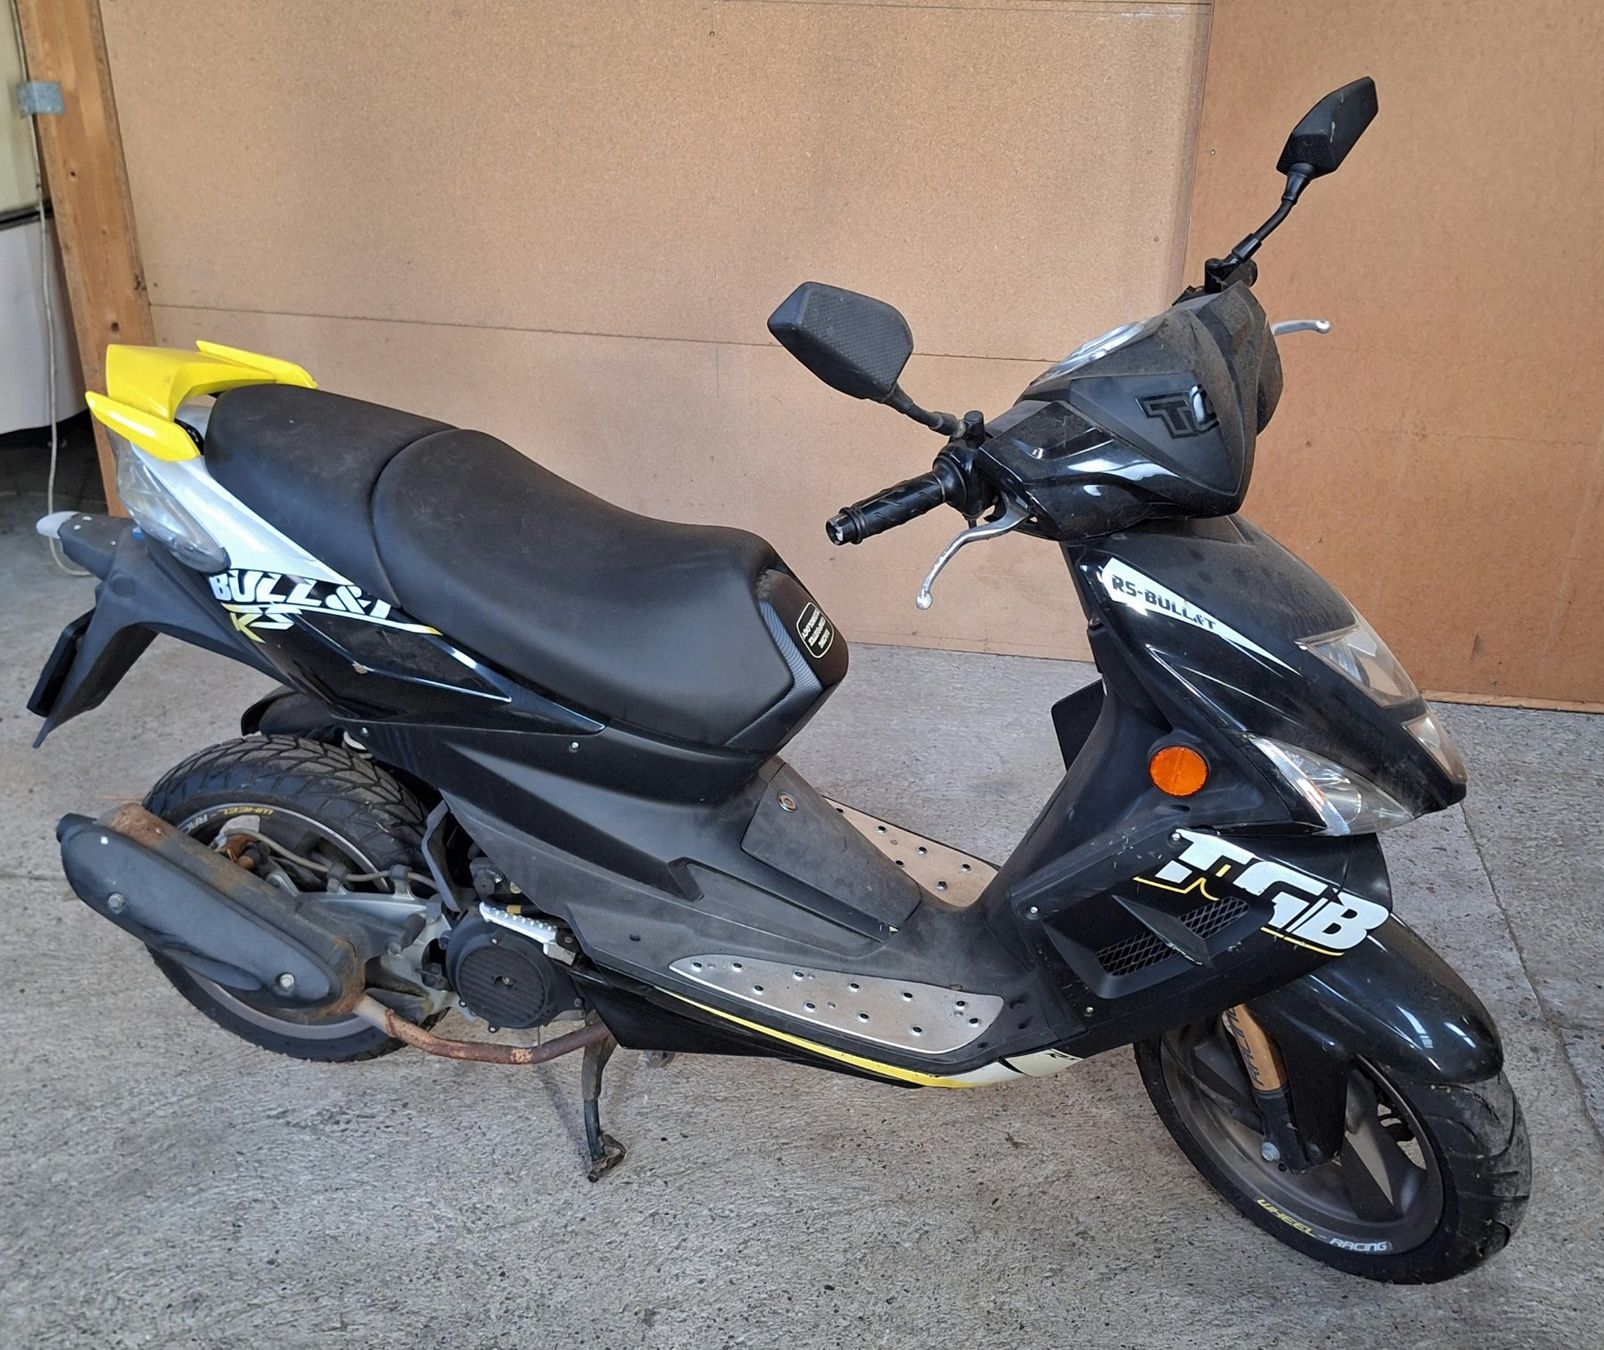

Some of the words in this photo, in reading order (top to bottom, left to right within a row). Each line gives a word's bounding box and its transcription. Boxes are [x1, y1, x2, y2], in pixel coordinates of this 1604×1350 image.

[1154, 829, 1390, 951] TGB
[1256, 1199, 1318, 1238] WHEEL
[1329, 1238, 1388, 1252] RACING
